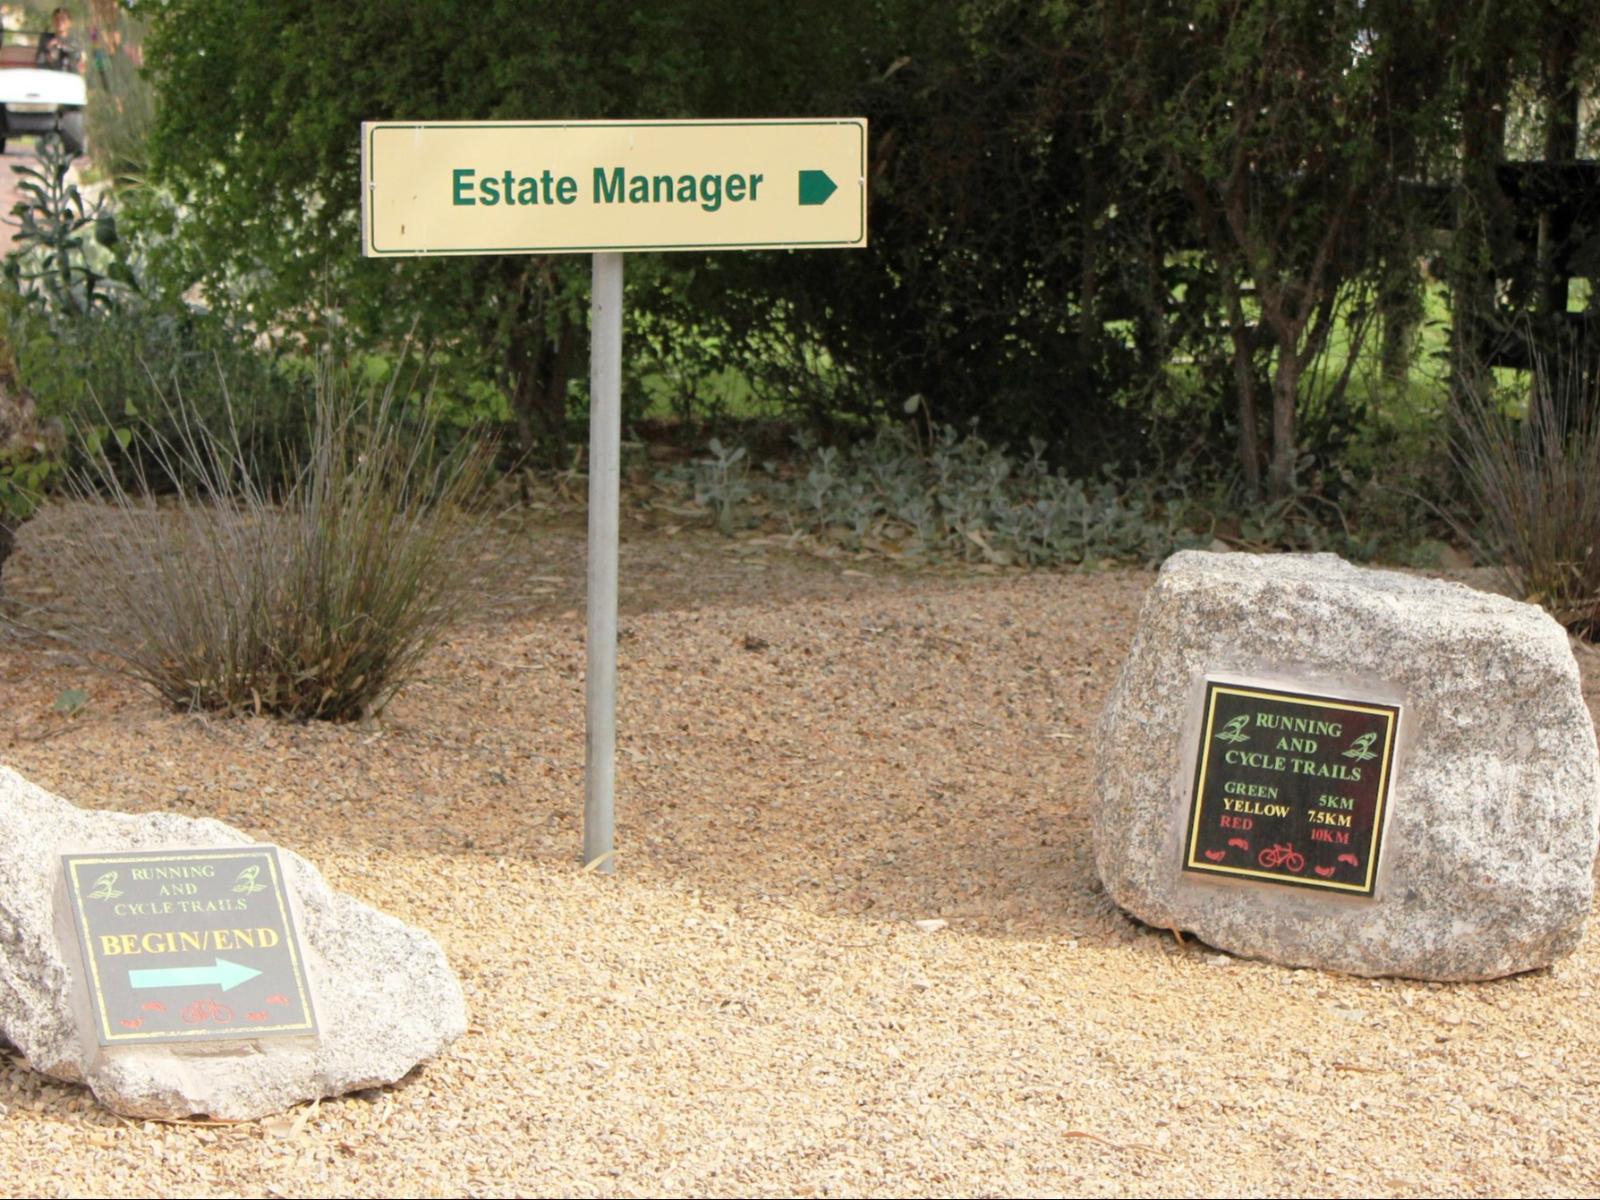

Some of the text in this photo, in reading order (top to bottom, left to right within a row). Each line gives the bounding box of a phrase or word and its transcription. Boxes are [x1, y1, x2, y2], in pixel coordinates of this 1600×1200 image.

[453, 166, 763, 213] Estate Manager
[1256, 712, 1342, 737] RUNNING
[1276, 737, 1317, 754] AND
[1225, 751, 1361, 781] CYCLE TRAILS
[1224, 781, 1354, 811] GREEN 5KM
[1223, 798, 1352, 827] YELLOW 7.5KM
[1220, 816, 1349, 845] RED 10KM
[131, 865, 215, 880] RUNNING
[159, 883, 197, 896] AND
[114, 899, 248, 916] CYCLE TRAILS
[99, 927, 279, 956] BEGIN/END
